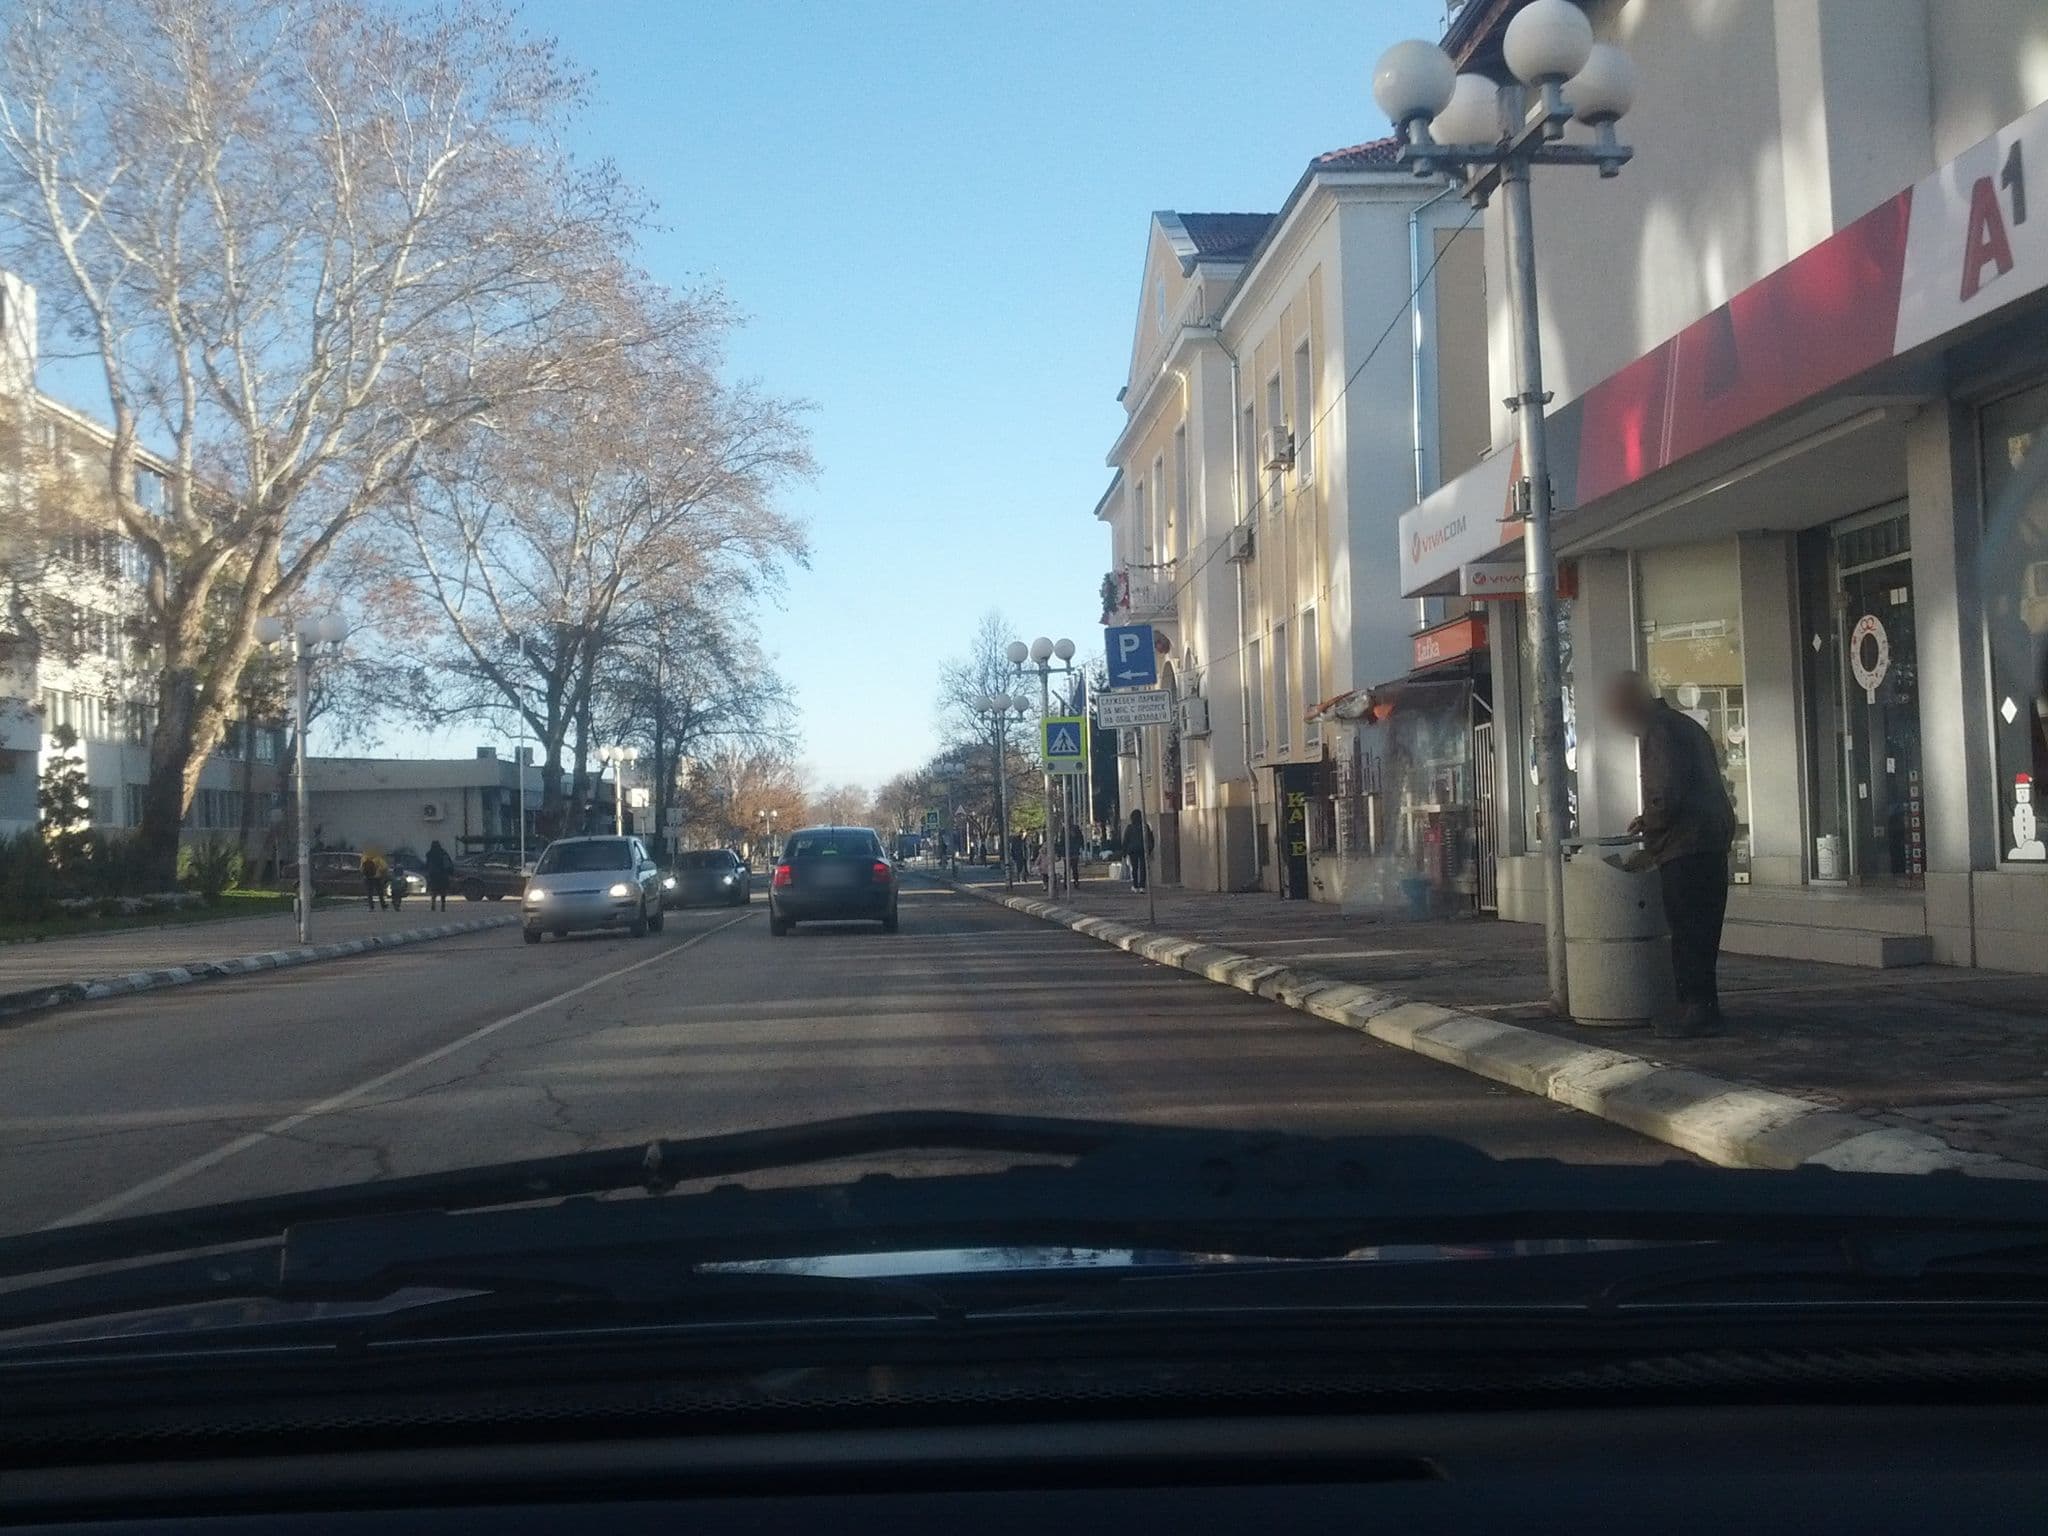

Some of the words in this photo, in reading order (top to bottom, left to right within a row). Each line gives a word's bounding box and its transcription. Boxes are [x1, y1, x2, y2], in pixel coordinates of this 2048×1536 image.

[1960, 138, 2027, 302] A1
[1422, 515, 1467, 553] VIVACOM
[1119, 633, 1140, 663] P
